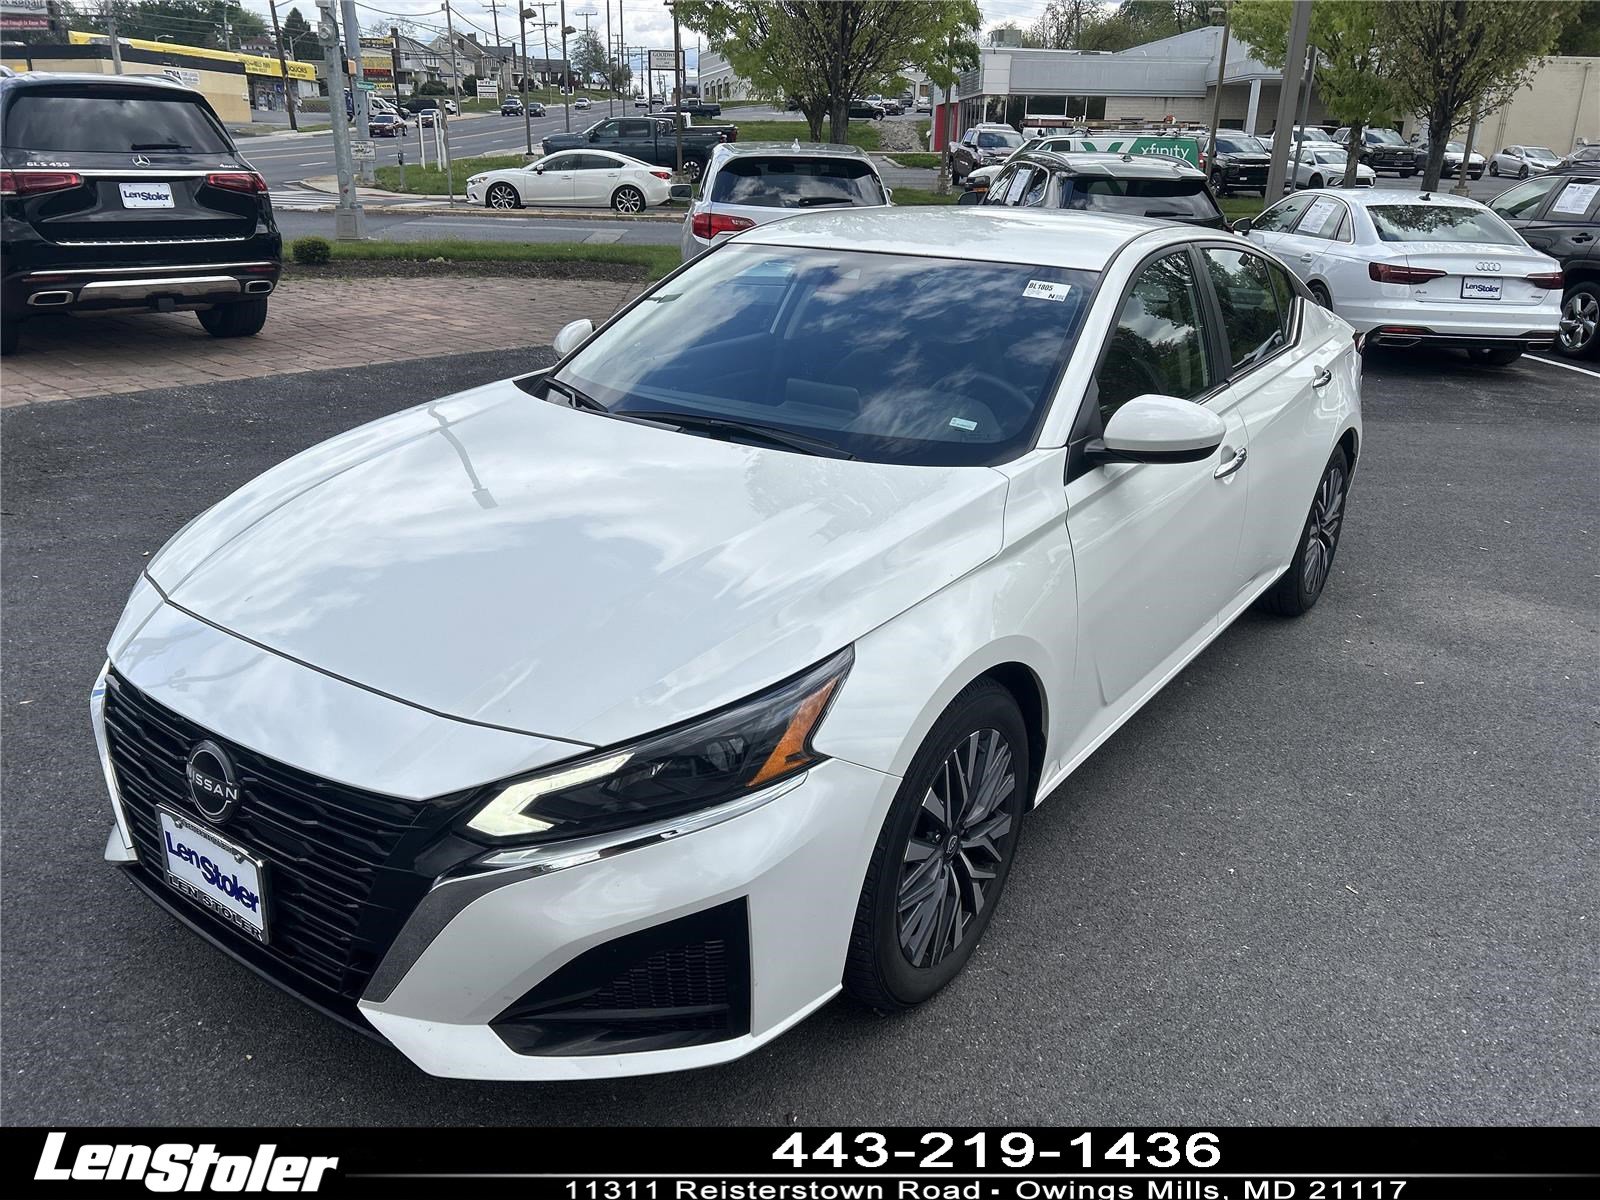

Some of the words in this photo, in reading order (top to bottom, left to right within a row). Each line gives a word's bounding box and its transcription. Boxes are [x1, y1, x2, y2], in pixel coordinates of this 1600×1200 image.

[1141, 143, 1189, 160] xfinity
[123, 190, 169, 201] LenStoler
[1465, 282, 1499, 292] LenStoler
[187, 766, 238, 800] NISSAN
[165, 830, 259, 913] LenStoler
[169, 875, 199, 899] LEN
[203, 894, 263, 942] STOLER
